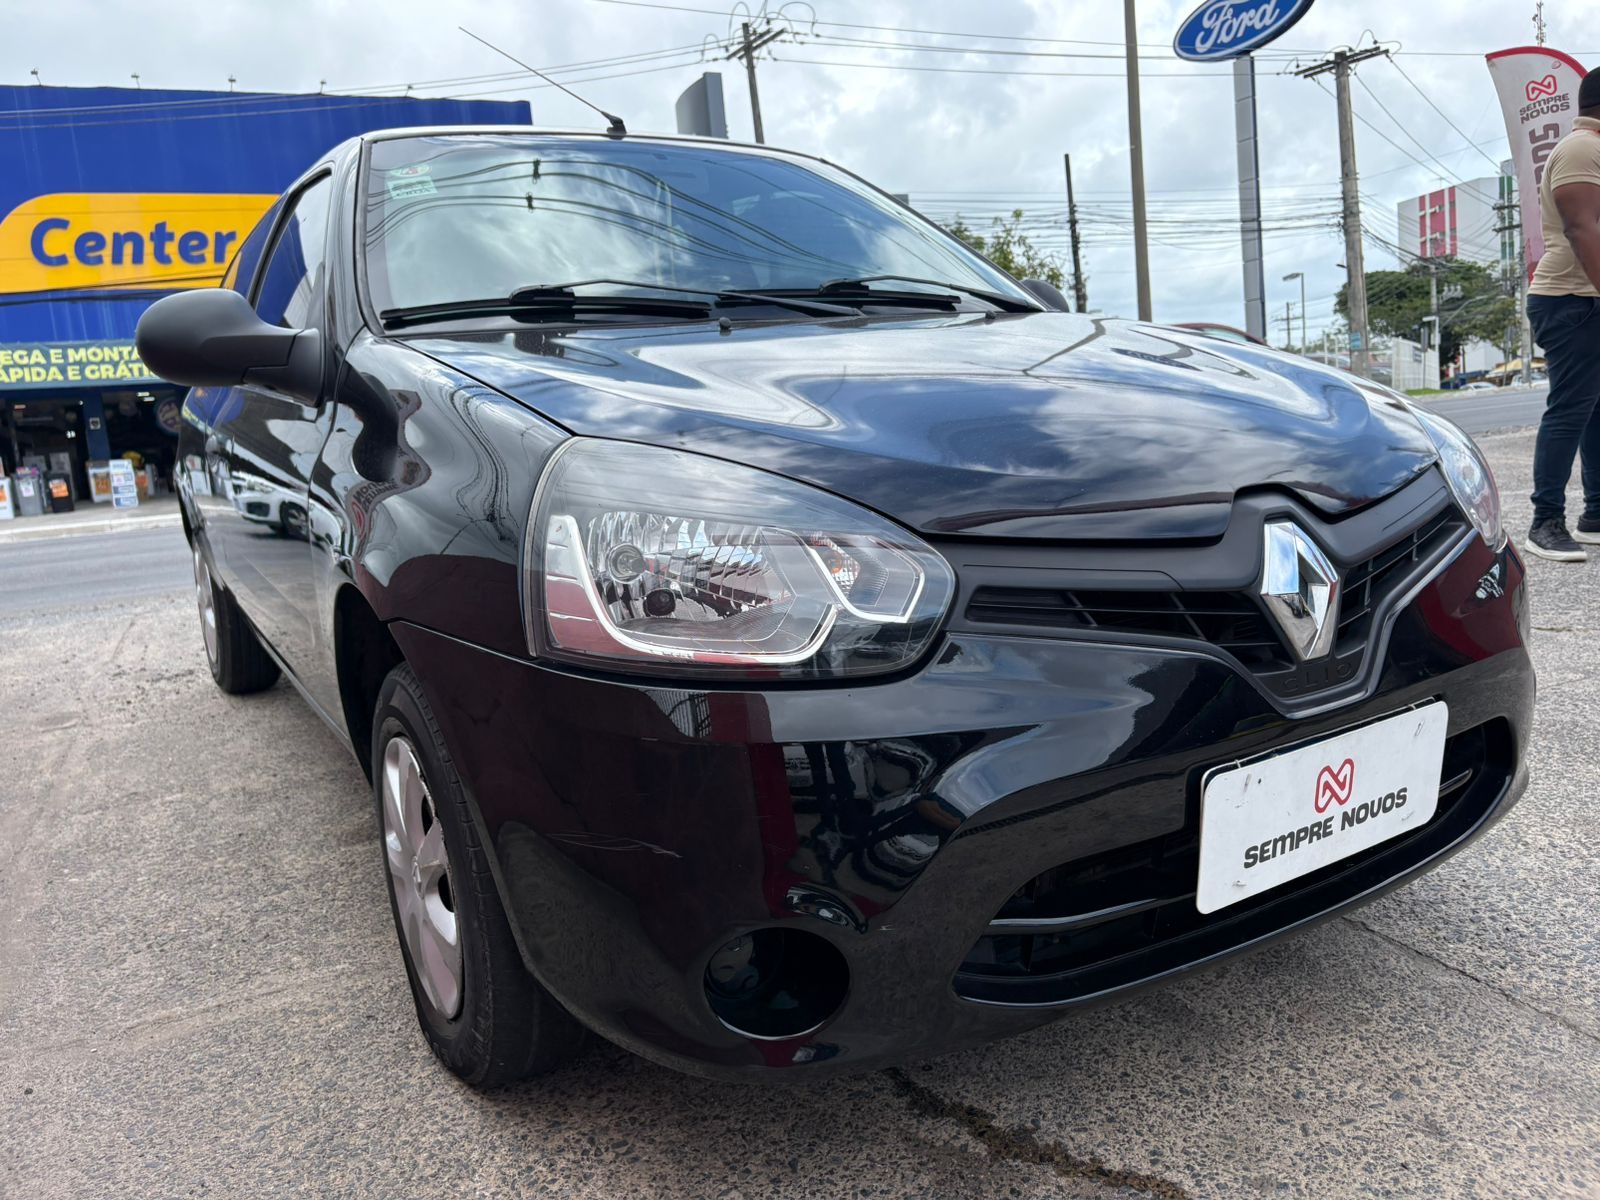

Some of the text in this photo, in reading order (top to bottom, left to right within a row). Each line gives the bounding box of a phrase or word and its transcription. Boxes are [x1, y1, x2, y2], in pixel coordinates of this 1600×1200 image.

[1195, 0, 1280, 53] Ford
[1519, 93, 1570, 116] SEMPRE
[1520, 101, 1570, 124] NOVOS
[30, 217, 237, 267] Center
[0, 349, 47, 365] EGA
[50, 348, 64, 363] E
[67, 365, 81, 380] E
[1281, 662, 1353, 693] CLIO
[1243, 787, 1408, 869] SEMPRE NOVOS
